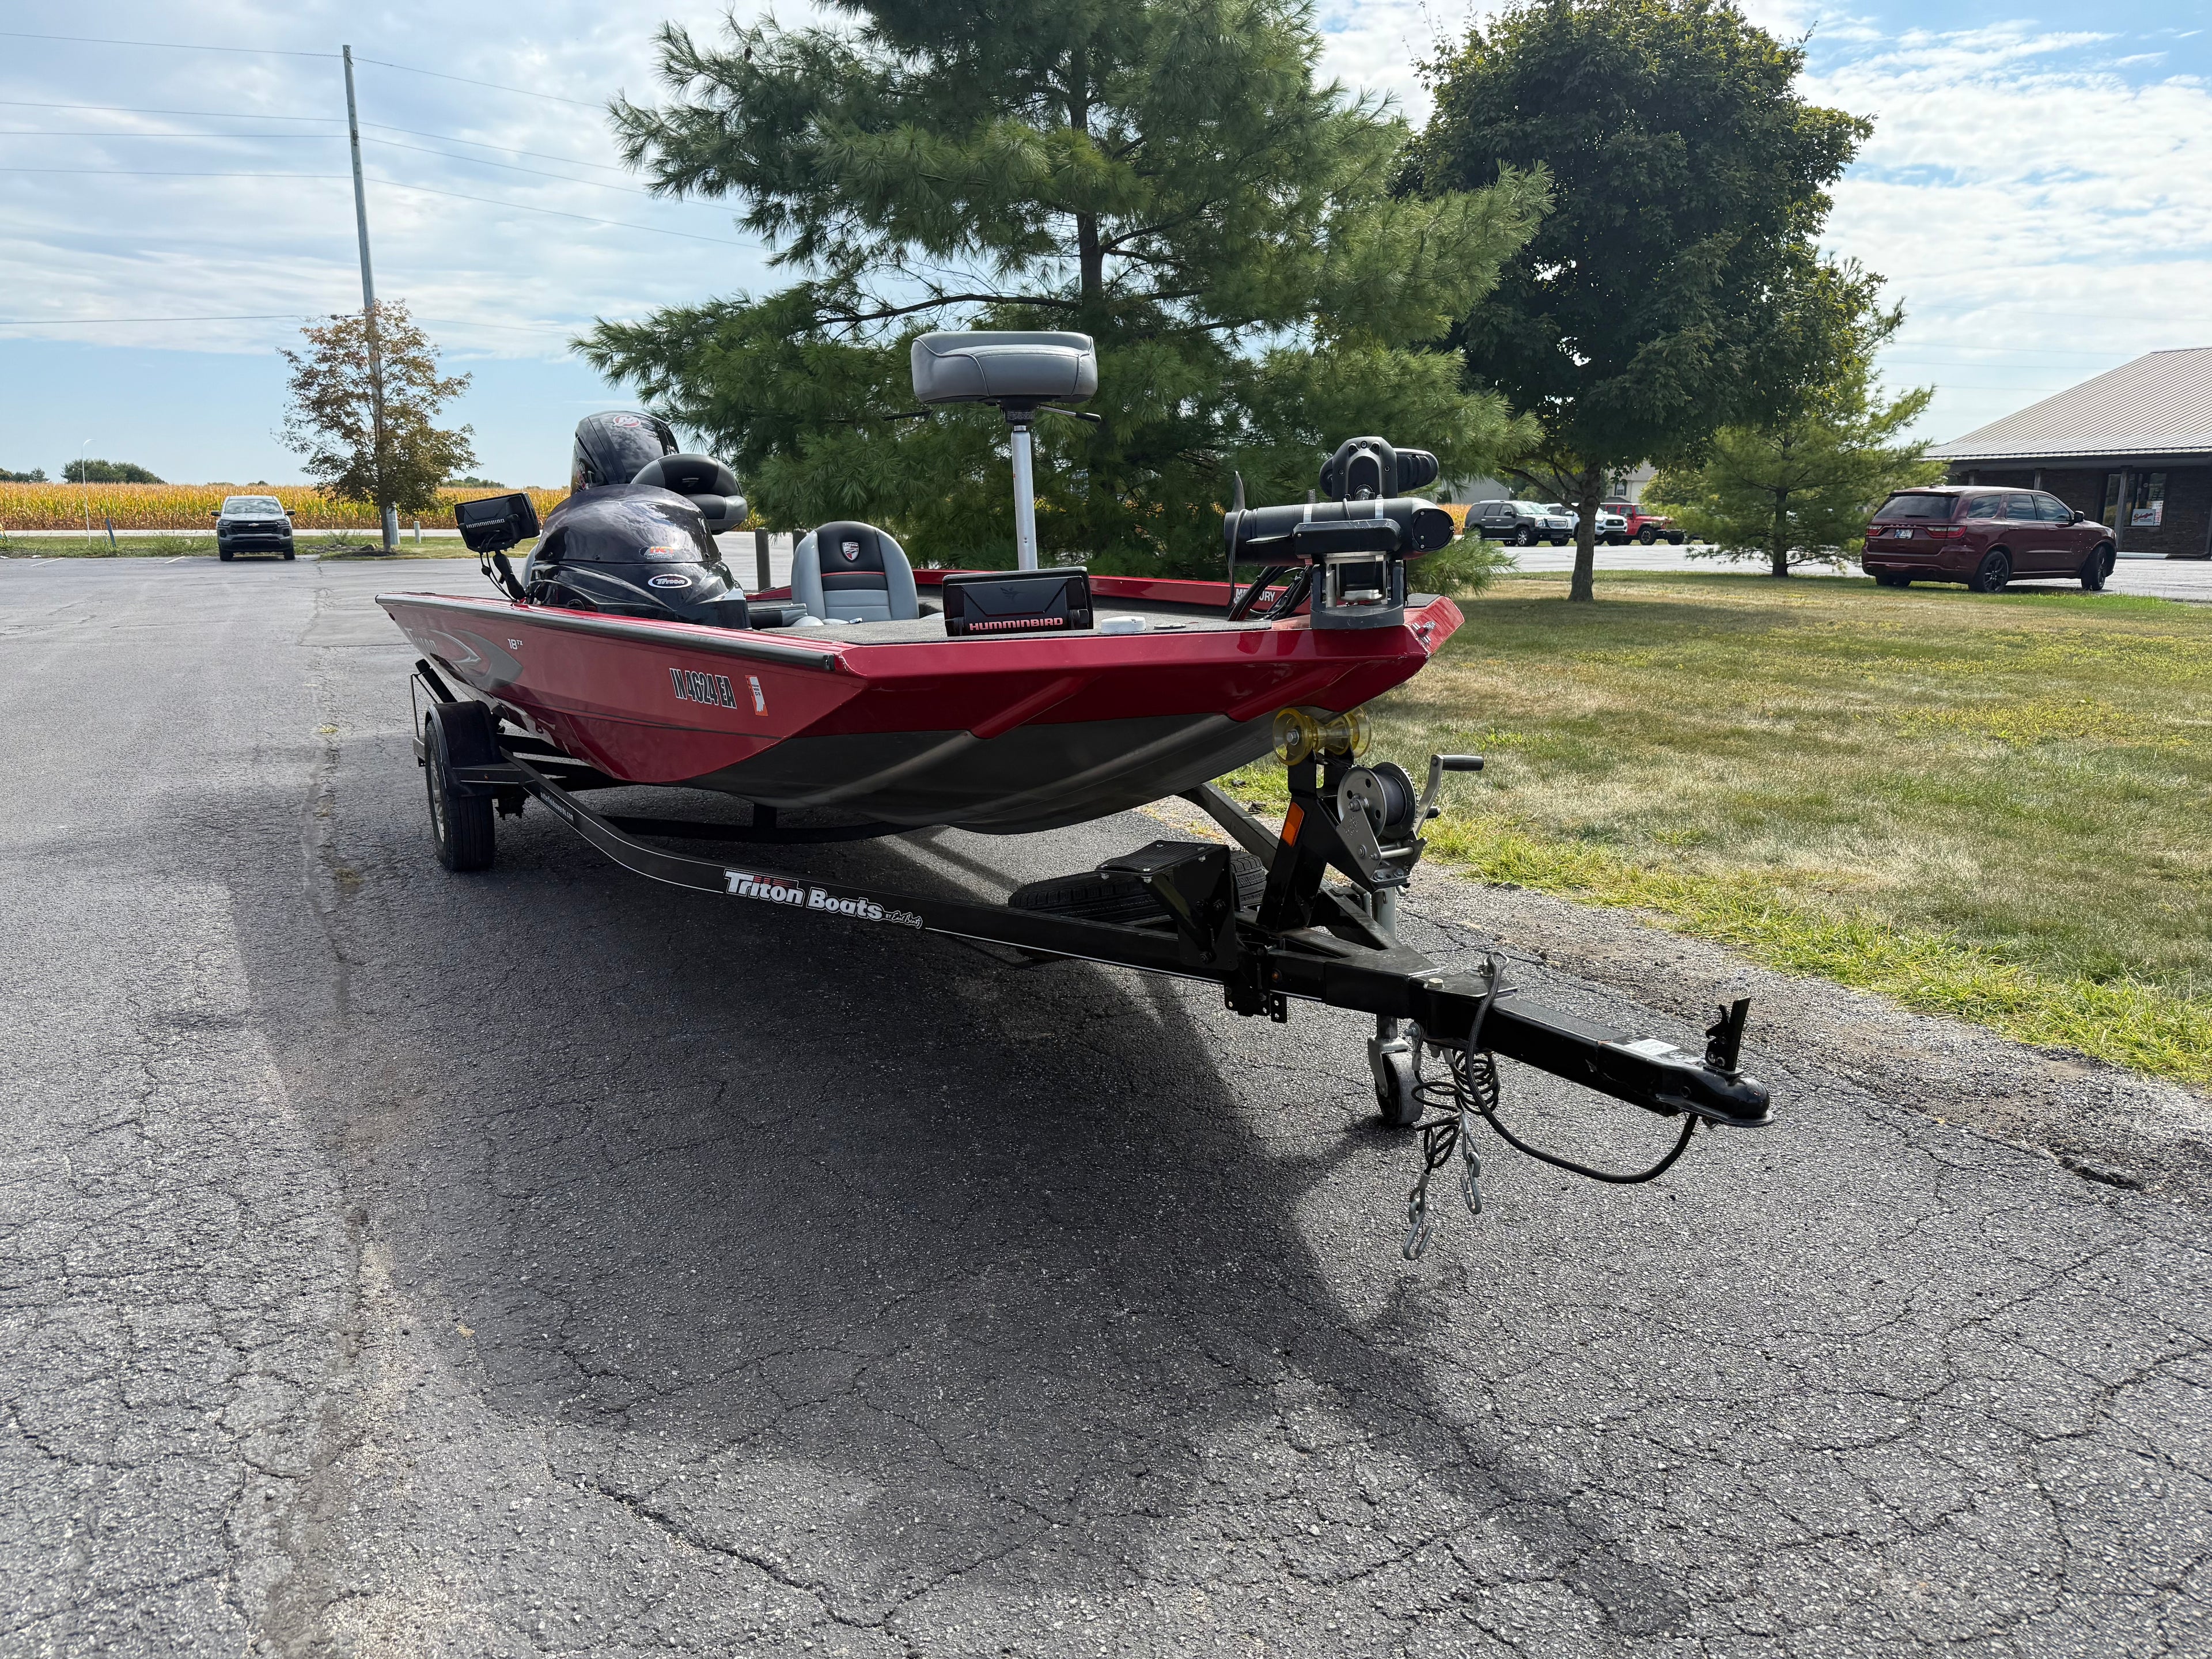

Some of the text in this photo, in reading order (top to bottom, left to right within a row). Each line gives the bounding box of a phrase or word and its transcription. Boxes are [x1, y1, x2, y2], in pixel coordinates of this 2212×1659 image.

[466, 518, 505, 529] HUMMINBIRD
[969, 618, 1063, 631] HUMMINBIRD
[669, 668, 688, 700] IN
[685, 670, 719, 706] 4624
[715, 675, 737, 709] EA
[724, 871, 804, 905] Triton
[808, 889, 883, 920] Boats
